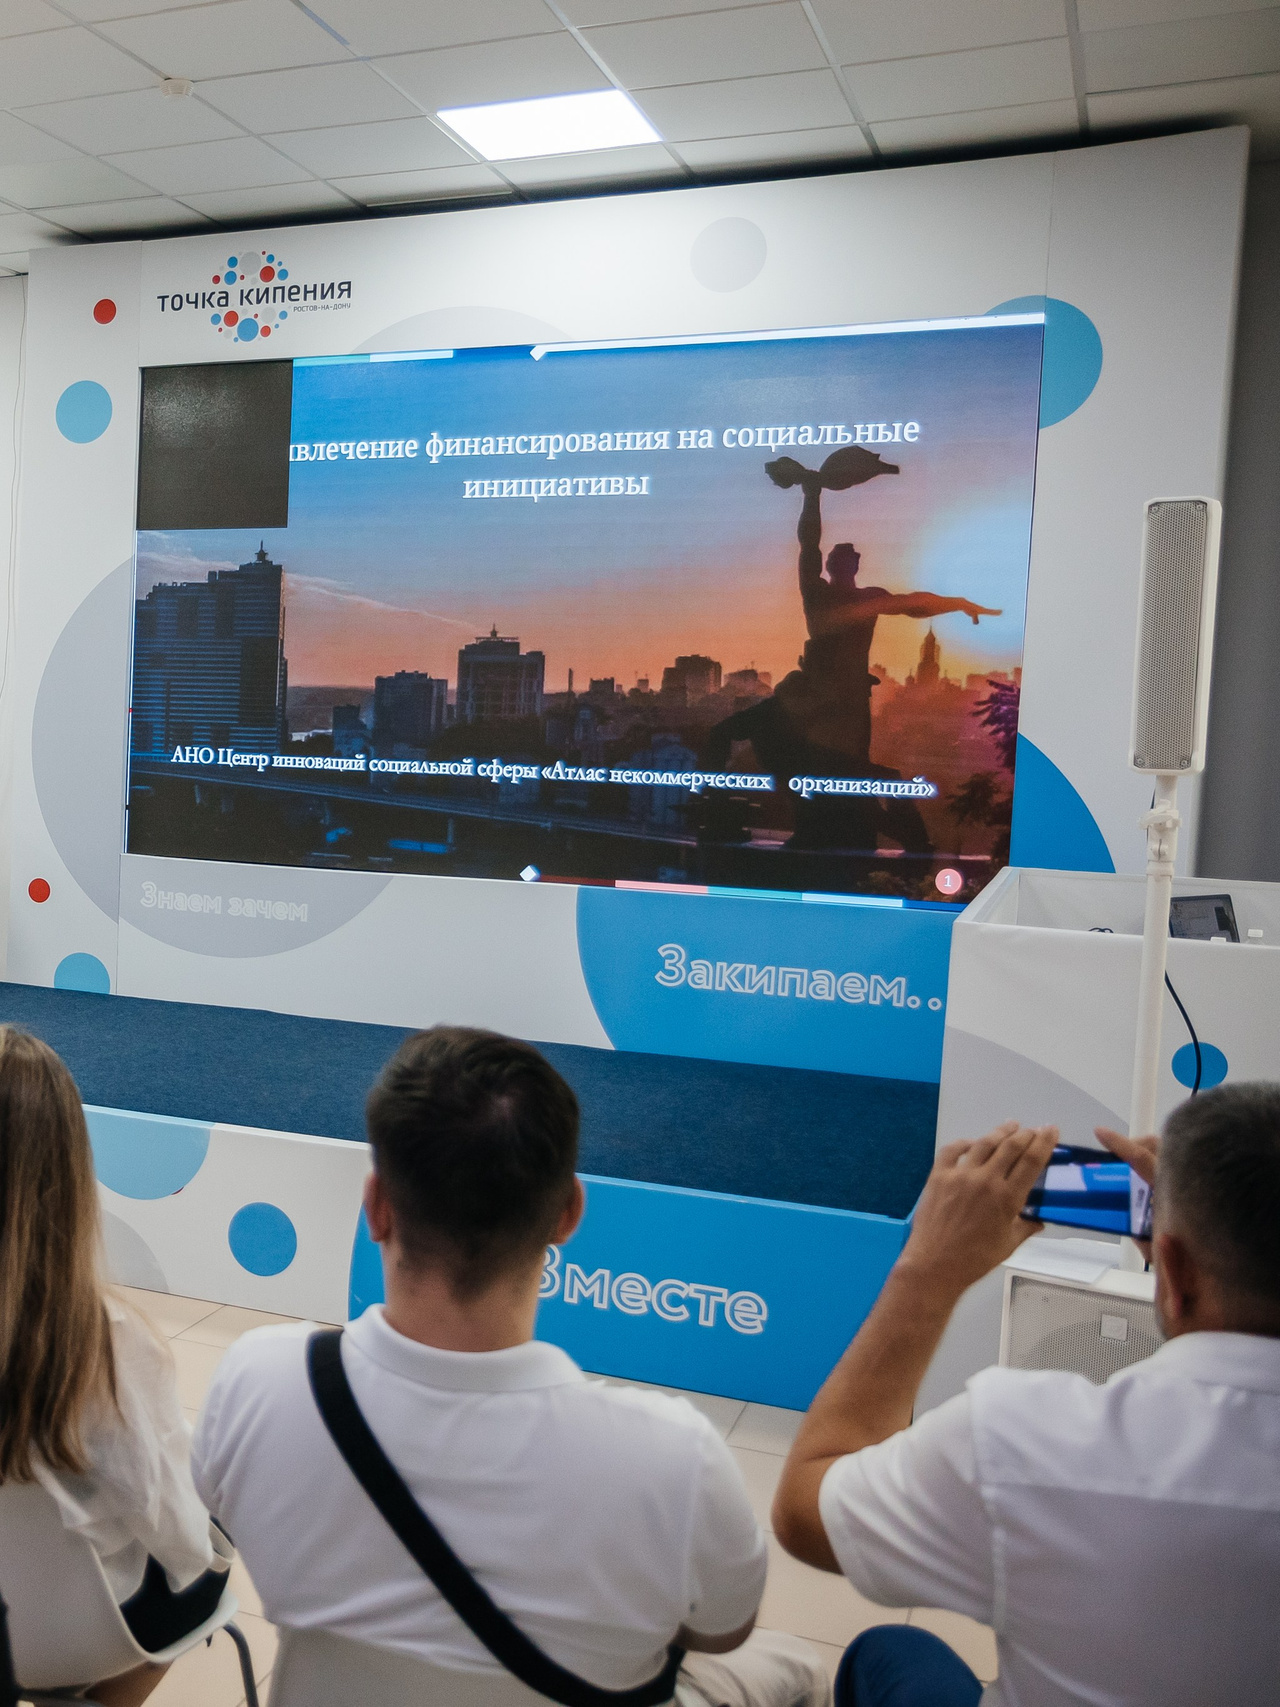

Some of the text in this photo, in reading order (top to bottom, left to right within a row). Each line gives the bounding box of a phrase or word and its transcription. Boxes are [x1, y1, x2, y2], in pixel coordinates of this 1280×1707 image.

[157, 281, 352, 312] точка кипения
[293, 303, 351, 312] РОСТОВ-НА-ДОНУ
[425, 430, 670, 464] финансирования
[676, 428, 714, 450] на
[722, 421, 920, 453] социальные
[462, 476, 650, 503] инициативы
[171, 745, 935, 799] АНО Центр инноваций социальной сферы «Атлас некоммерческих организаций»
[943, 875, 952, 887] 1
[140, 881, 309, 923] Знаем зачем
